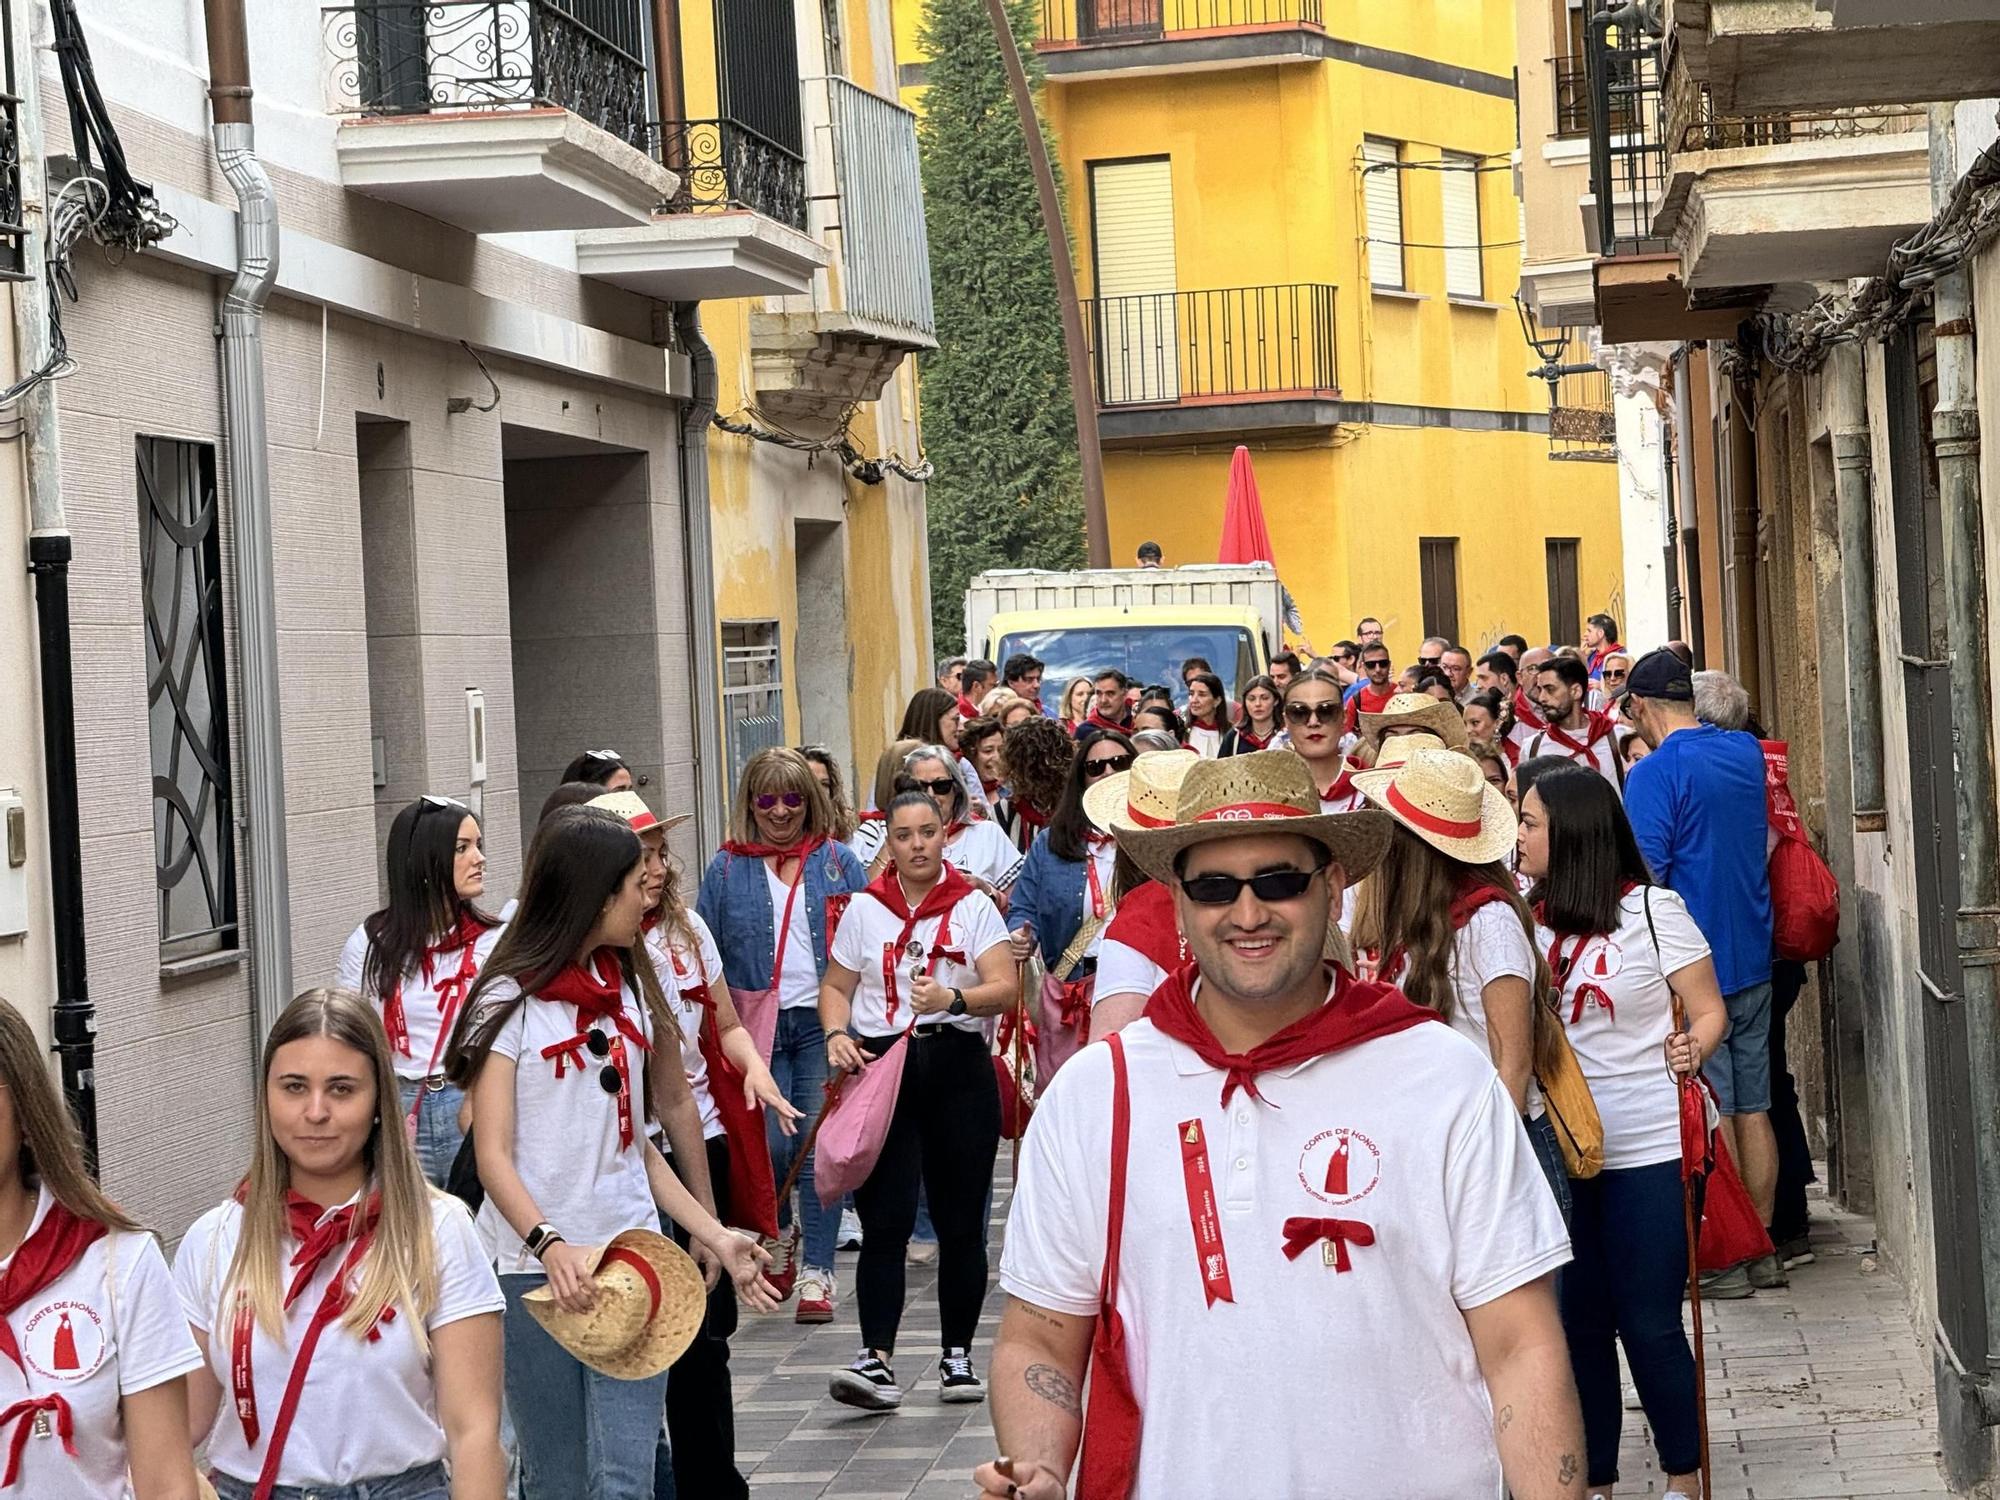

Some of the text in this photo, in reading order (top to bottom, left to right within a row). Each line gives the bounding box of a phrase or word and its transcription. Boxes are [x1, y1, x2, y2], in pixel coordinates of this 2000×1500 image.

[1304, 1130, 1333, 1151] CORTE
[1351, 1130, 1380, 1157] HONOR
[26, 1301, 101, 1332] CORTE DE HONOR
